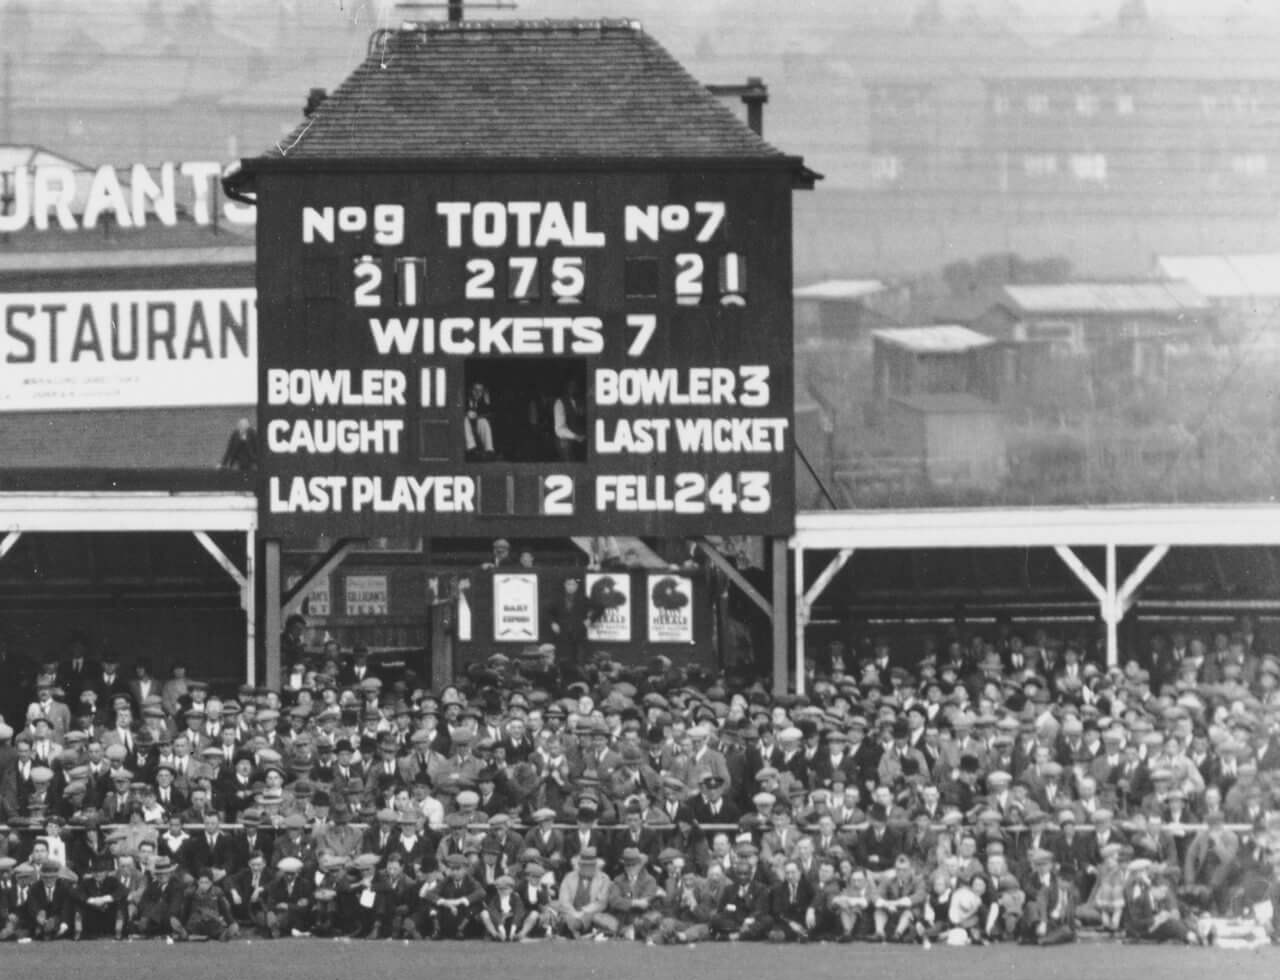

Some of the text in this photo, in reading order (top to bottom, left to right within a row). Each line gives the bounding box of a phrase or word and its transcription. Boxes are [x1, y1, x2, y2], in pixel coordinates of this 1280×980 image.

[436, 201, 606, 248] TOTAL
[353, 263, 417, 307] 21
[465, 256, 586, 301] 275
[675, 252, 740, 295] 21
[369, 314, 657, 357] WICKETS 7
[267, 368, 407, 406] BOWLER
[594, 364, 771, 407] BOWLER 3
[267, 418, 404, 454] CAUGHT
[595, 416, 790, 454] LAST WICKET
[269, 474, 575, 516] LAST PLAYER 2
[595, 470, 772, 514] FELL 243
